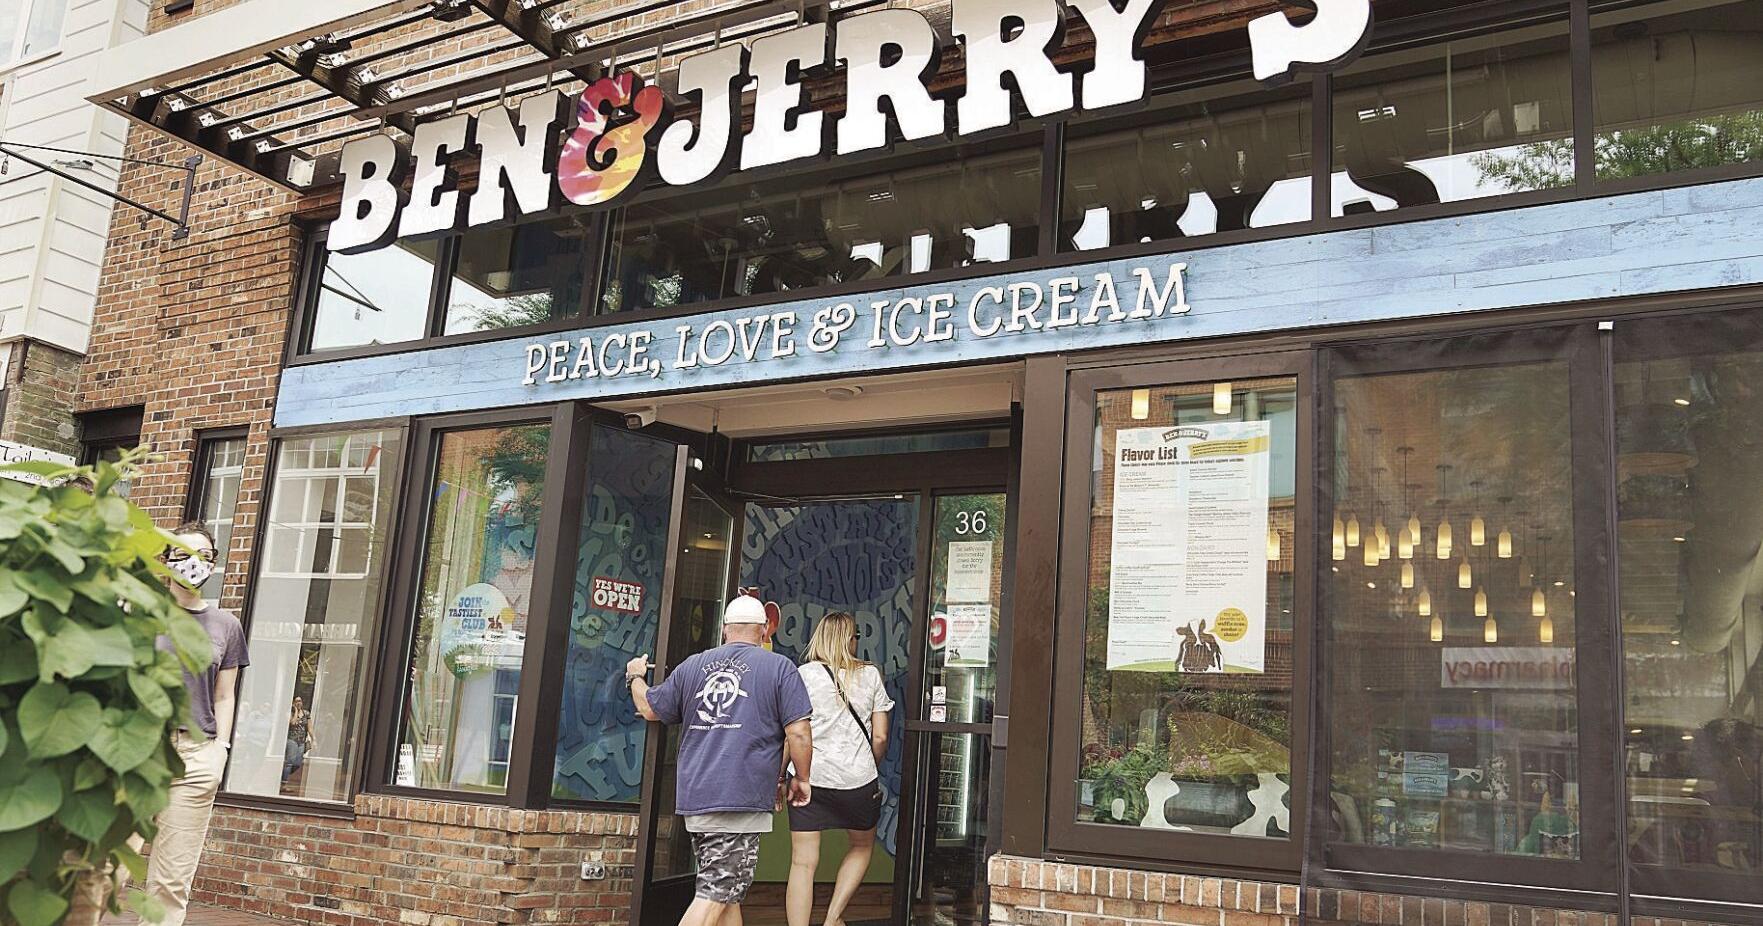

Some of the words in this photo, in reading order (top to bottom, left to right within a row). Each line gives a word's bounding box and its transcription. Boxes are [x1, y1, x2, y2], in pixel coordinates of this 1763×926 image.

[327, 88, 563, 254] BEN
[558, 71, 665, 206] &
[657, 0, 1372, 187] JERRYS
[522, 327, 663, 387] PEACE,
[673, 312, 797, 369] LOVE
[806, 303, 856, 353] &
[868, 292, 956, 348] ICE
[966, 262, 1192, 338] CREAM
[1120, 447, 1155, 462] Flavor
[1158, 446, 1178, 460] List
[955, 511, 987, 535] 36
[595, 579, 612, 591] YES
[613, 581, 641, 596] WE'RE
[458, 597, 482, 608] JOIN
[593, 590, 640, 612] OPEN
[448, 608, 483, 618] TASTIEST
[461, 618, 486, 631] CLUB
